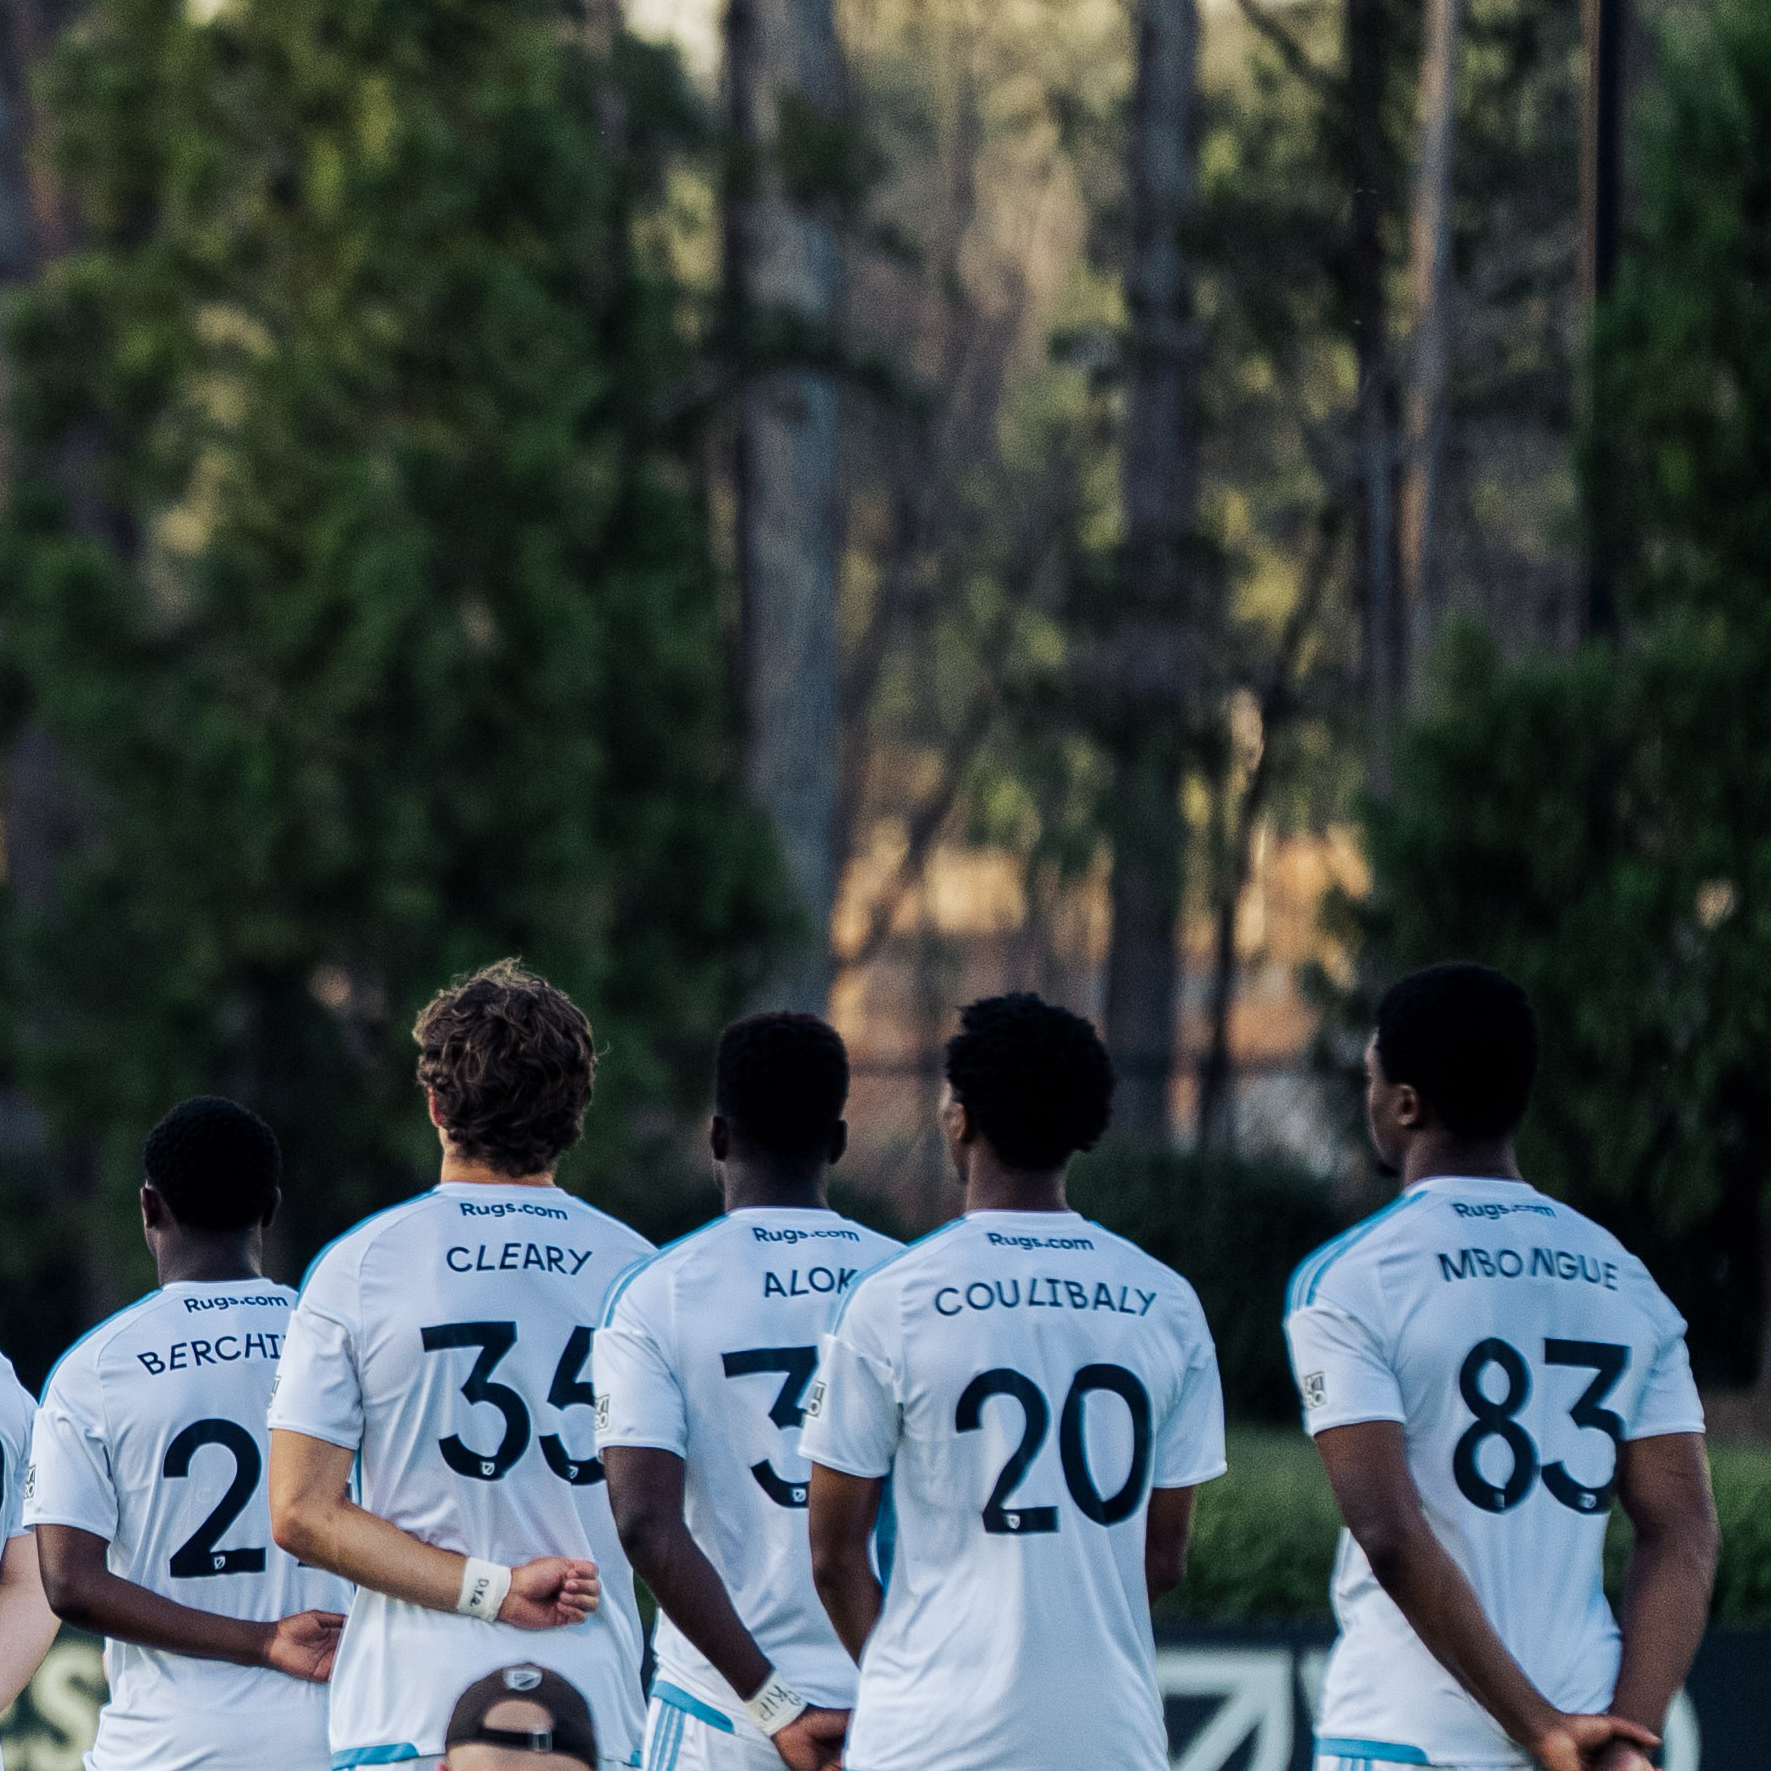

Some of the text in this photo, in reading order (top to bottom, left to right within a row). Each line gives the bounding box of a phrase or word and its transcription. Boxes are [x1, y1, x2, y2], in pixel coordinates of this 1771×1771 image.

[460, 1202, 568, 1221] Rugs.com
[752, 1226, 860, 1244] Rugs.com
[987, 1232, 1094, 1251] Rugs.com
[446, 1243, 592, 1276] CLEARY
[184, 1296, 288, 1313] Rugs.com
[935, 1278, 1157, 1316] COULIBALY
[137, 1333, 286, 1376] BERCHI
[1453, 1337, 1632, 1515] 83
[955, 1363, 1154, 1534] 20
